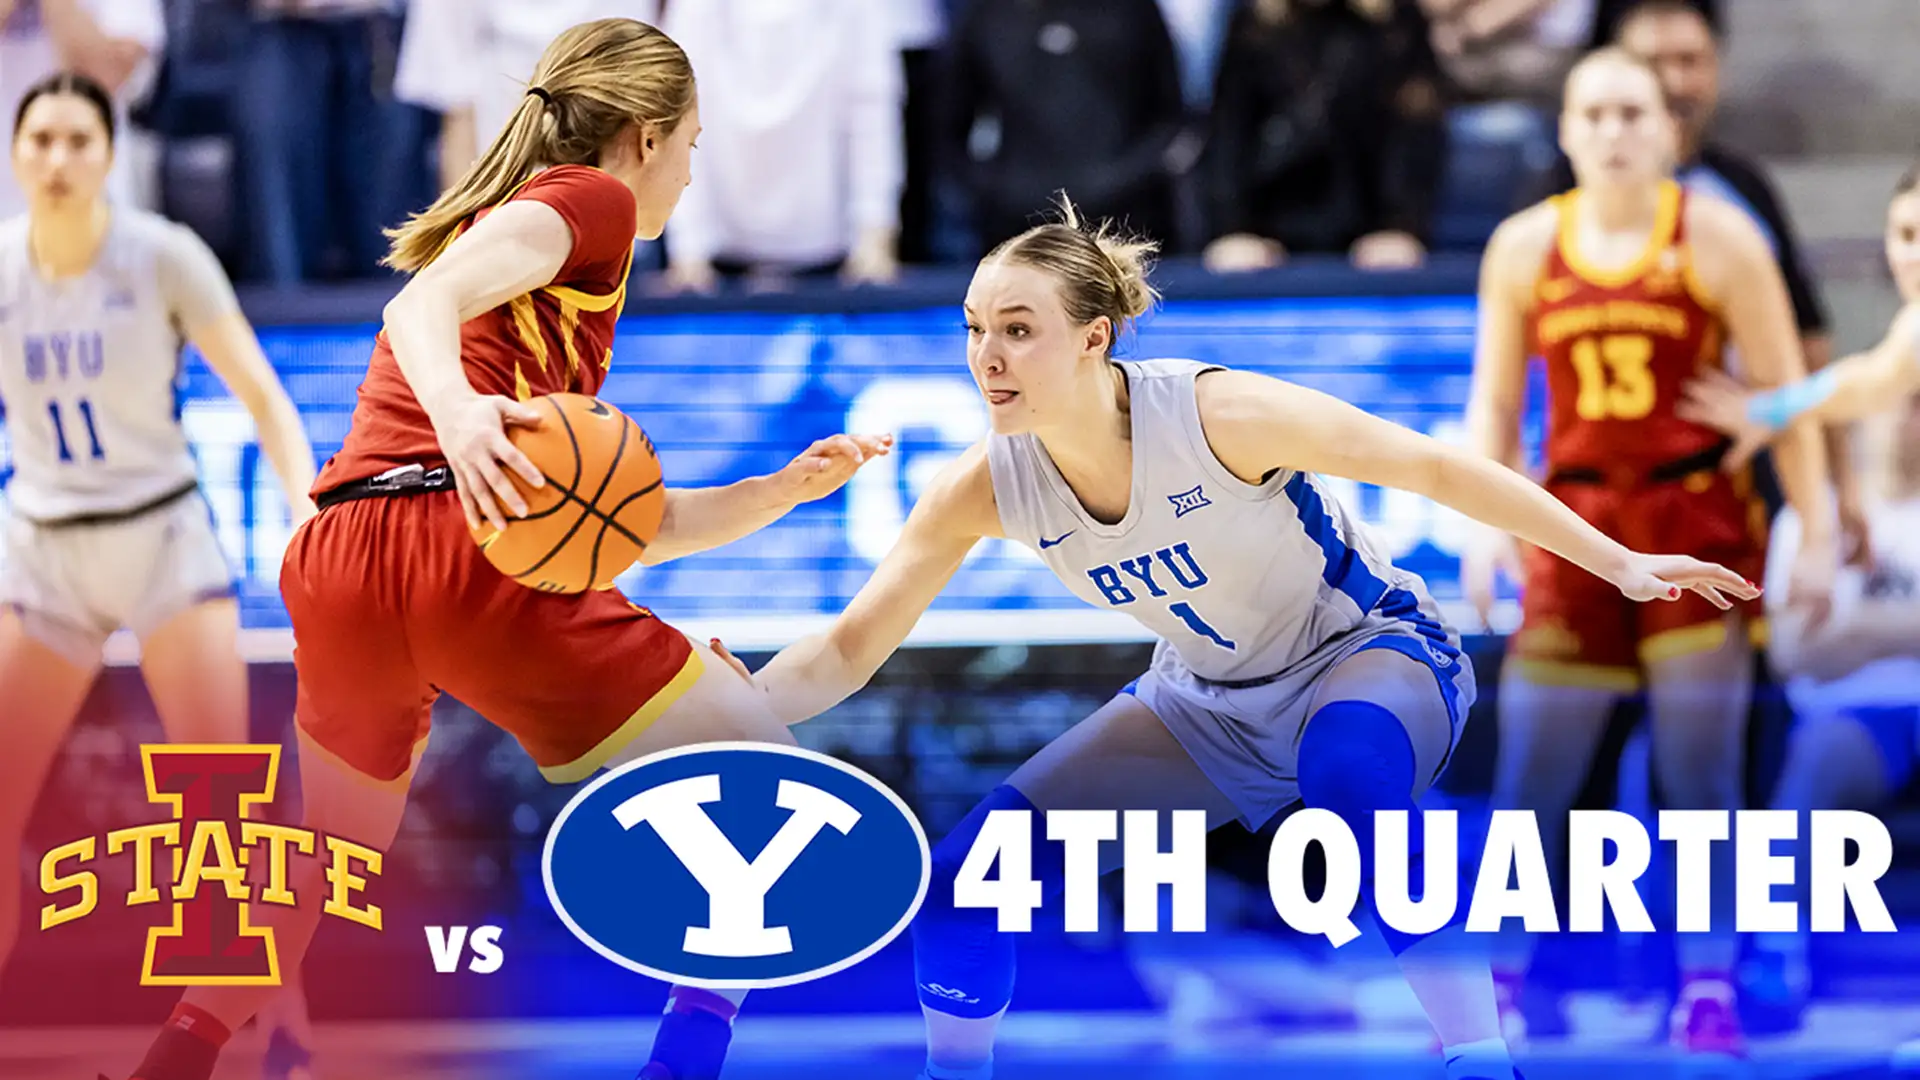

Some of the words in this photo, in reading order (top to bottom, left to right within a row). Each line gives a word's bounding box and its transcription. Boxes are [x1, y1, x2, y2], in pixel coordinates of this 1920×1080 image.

[1570, 334, 1657, 421] 13
[48, 397, 105, 463] 11
[1086, 541, 1209, 606] BYU
[1168, 602, 1236, 650] 1
